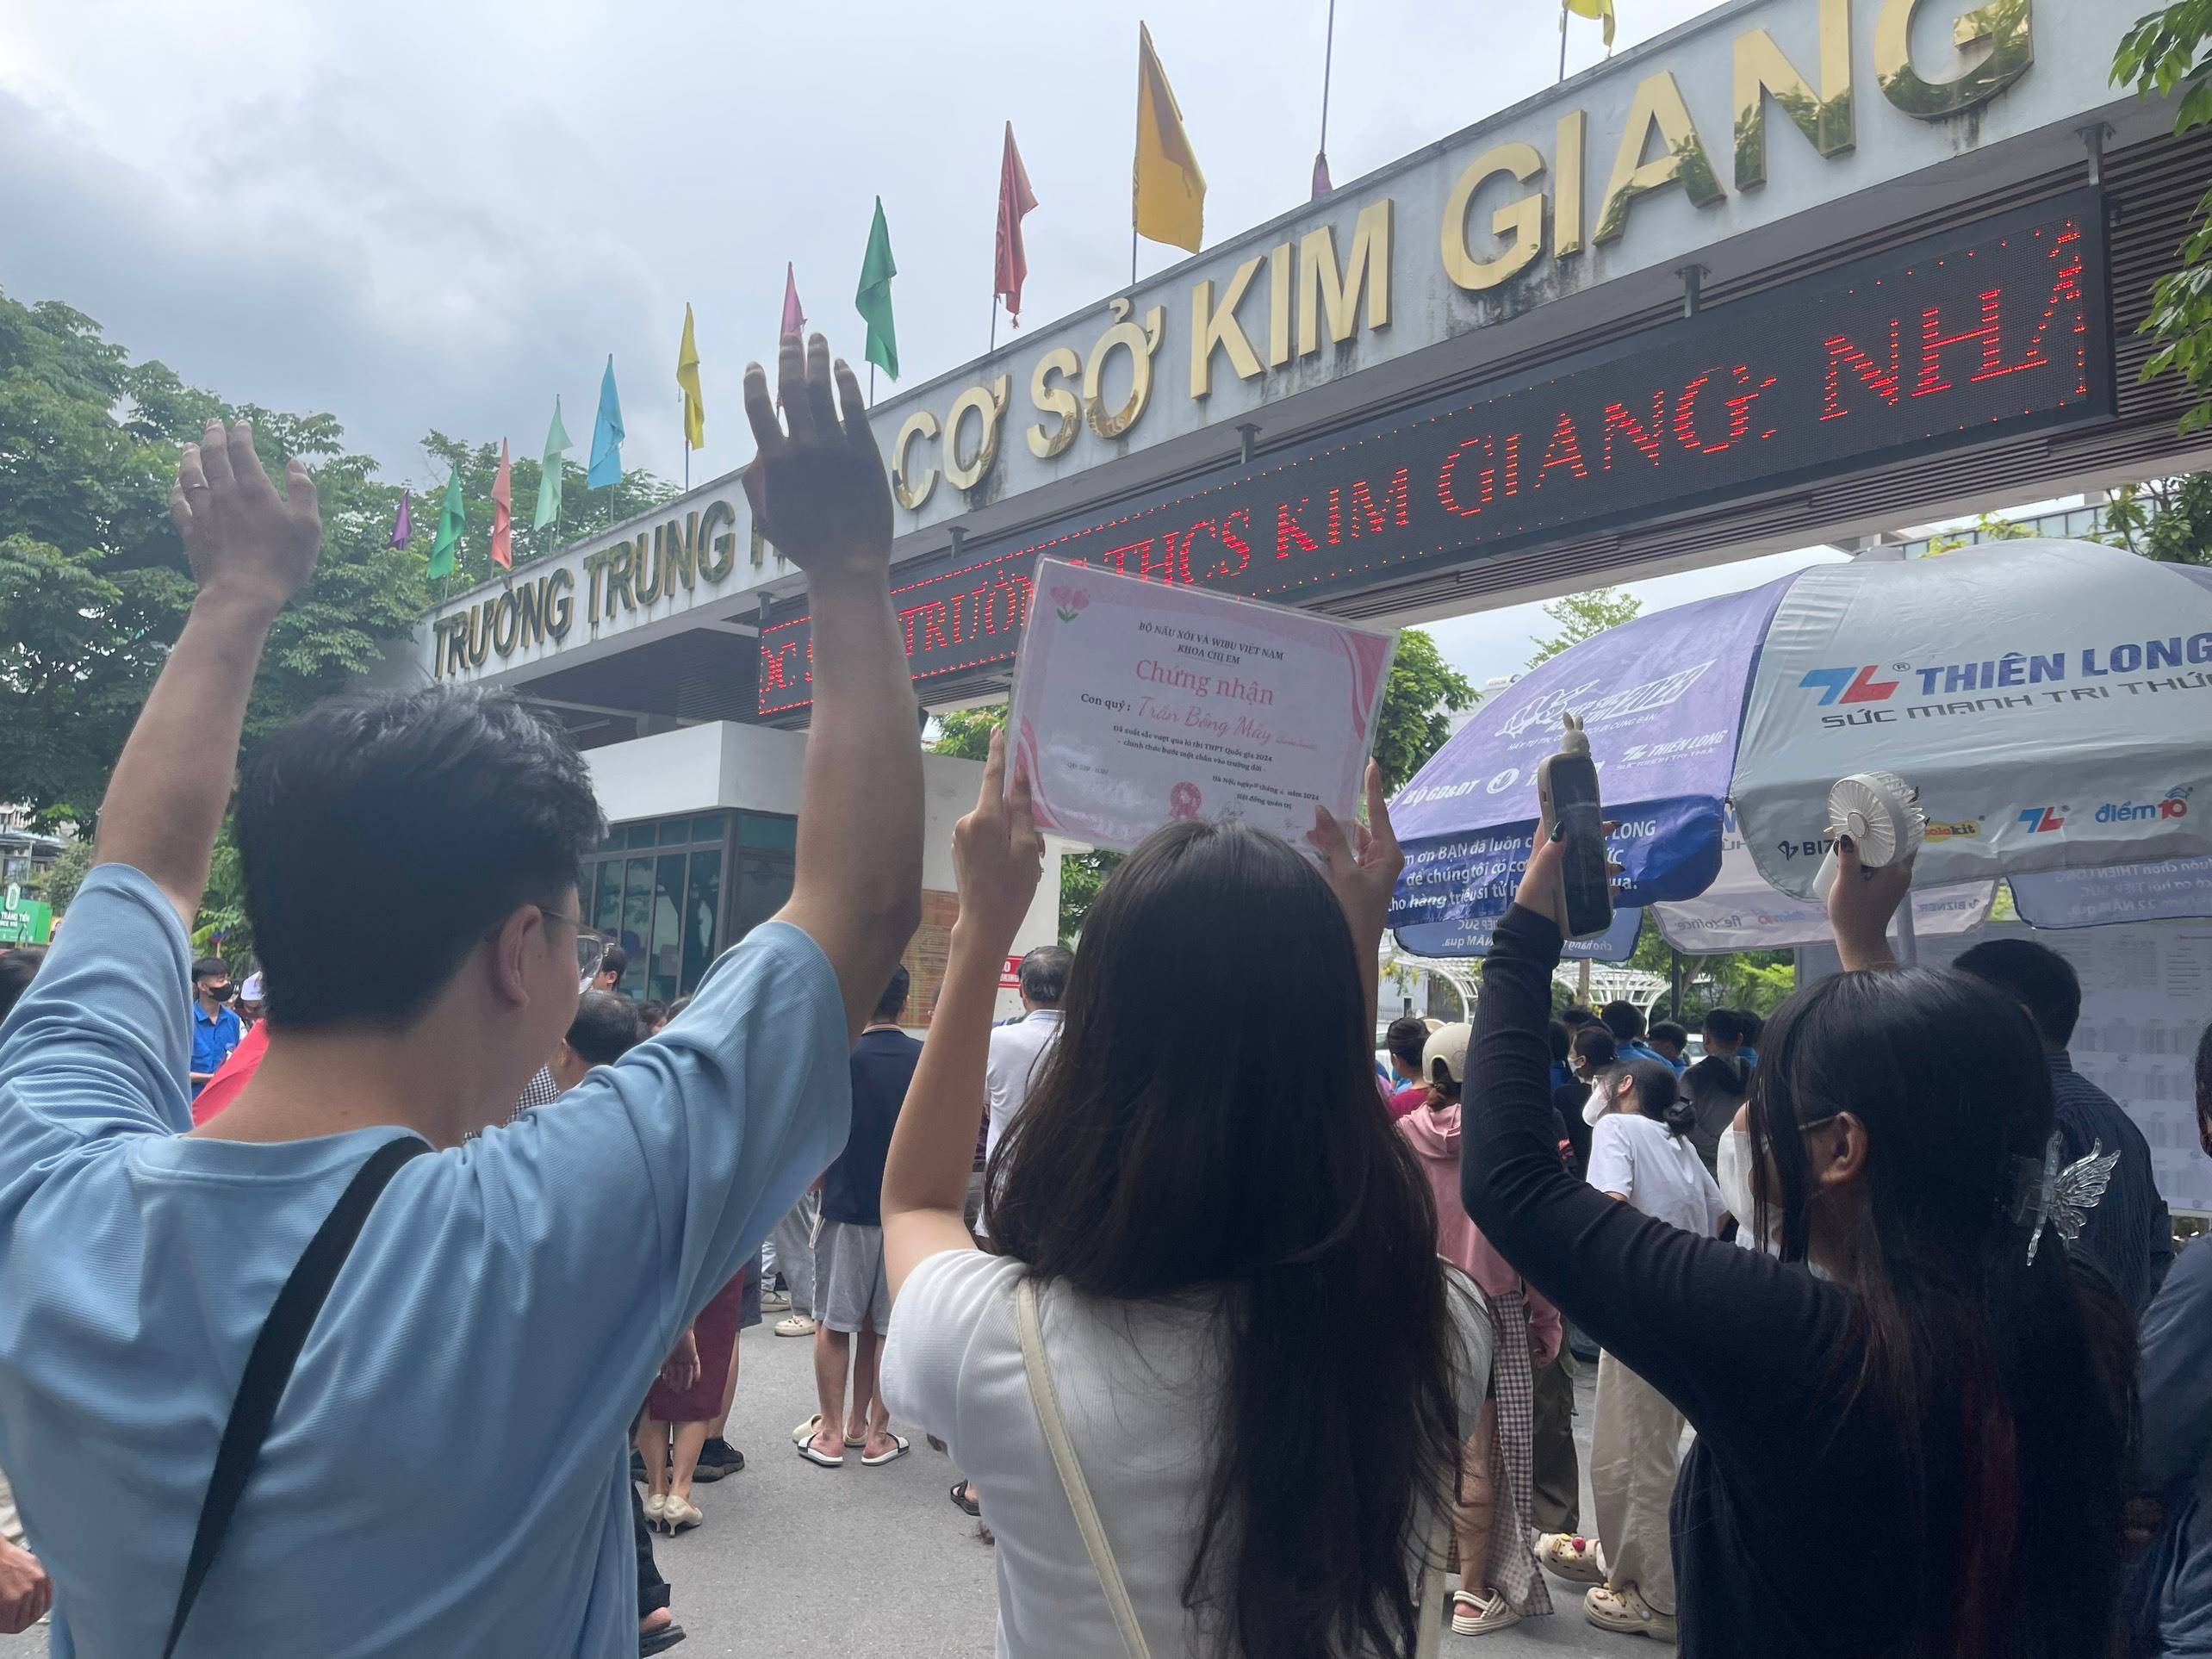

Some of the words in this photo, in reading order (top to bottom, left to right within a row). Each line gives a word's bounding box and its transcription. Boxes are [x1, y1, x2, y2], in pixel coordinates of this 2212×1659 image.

[892, 373, 1012, 510] CƠ
[1026, 296, 1167, 459] SỞ
[1189, 197, 1395, 401] KIM
[1440, 0, 2035, 291] GIANG
[899, 569, 1034, 656] TRƯỜ
[1104, 506, 1252, 587] THCS
[1276, 467, 1411, 560] KIM
[432, 567, 575, 679] TRƯỜNG
[583, 500, 736, 624] TRUNG
[1139, 621, 1153, 634] BỘ
[1196, 634, 1209, 645] VÀ
[1212, 637, 1237, 650] WIBU
[1239, 642, 1261, 655] VIỆT
[1262, 649, 1285, 661] NAM
[1177, 644, 1205, 657] KHOA
[1207, 650, 1224, 662] CHỊ
[1226, 655, 1240, 665] EM
[1916, 651, 2066, 696] THIÊN
[2081, 631, 2212, 678] LONG
[1080, 693, 1103, 705] Con
[1136, 659, 1211, 698] Chứng
[1216, 677, 1275, 706] nhận
[1821, 709, 1898, 729] SỨC
[1906, 694, 2041, 720] MẠNH
[2041, 686, 2110, 704] TRI
[1171, 737, 1184, 747] qua
[1204, 743, 1224, 753] THPT
[1255, 753, 1273, 762] 2024
[1647, 737, 1691, 757] THIÊN
[1687, 730, 1729, 750] LONG
[1302, 792, 1320, 801] 2024
[1418, 849, 1435, 863] ơn
[1438, 842, 1467, 863] BẠN
[1469, 838, 1488, 855] đã
[1489, 836, 1521, 853] luôn
[1612, 819, 1656, 840] LONG
[1803, 839, 1836, 856] BIZ
[1406, 869, 1423, 887] để
[1426, 865, 1469, 885] chúng
[1470, 861, 1489, 879] tôi
[1491, 860, 1507, 874] có
[1410, 894, 1447, 910] hàng
[1449, 889, 1477, 906] triệu
